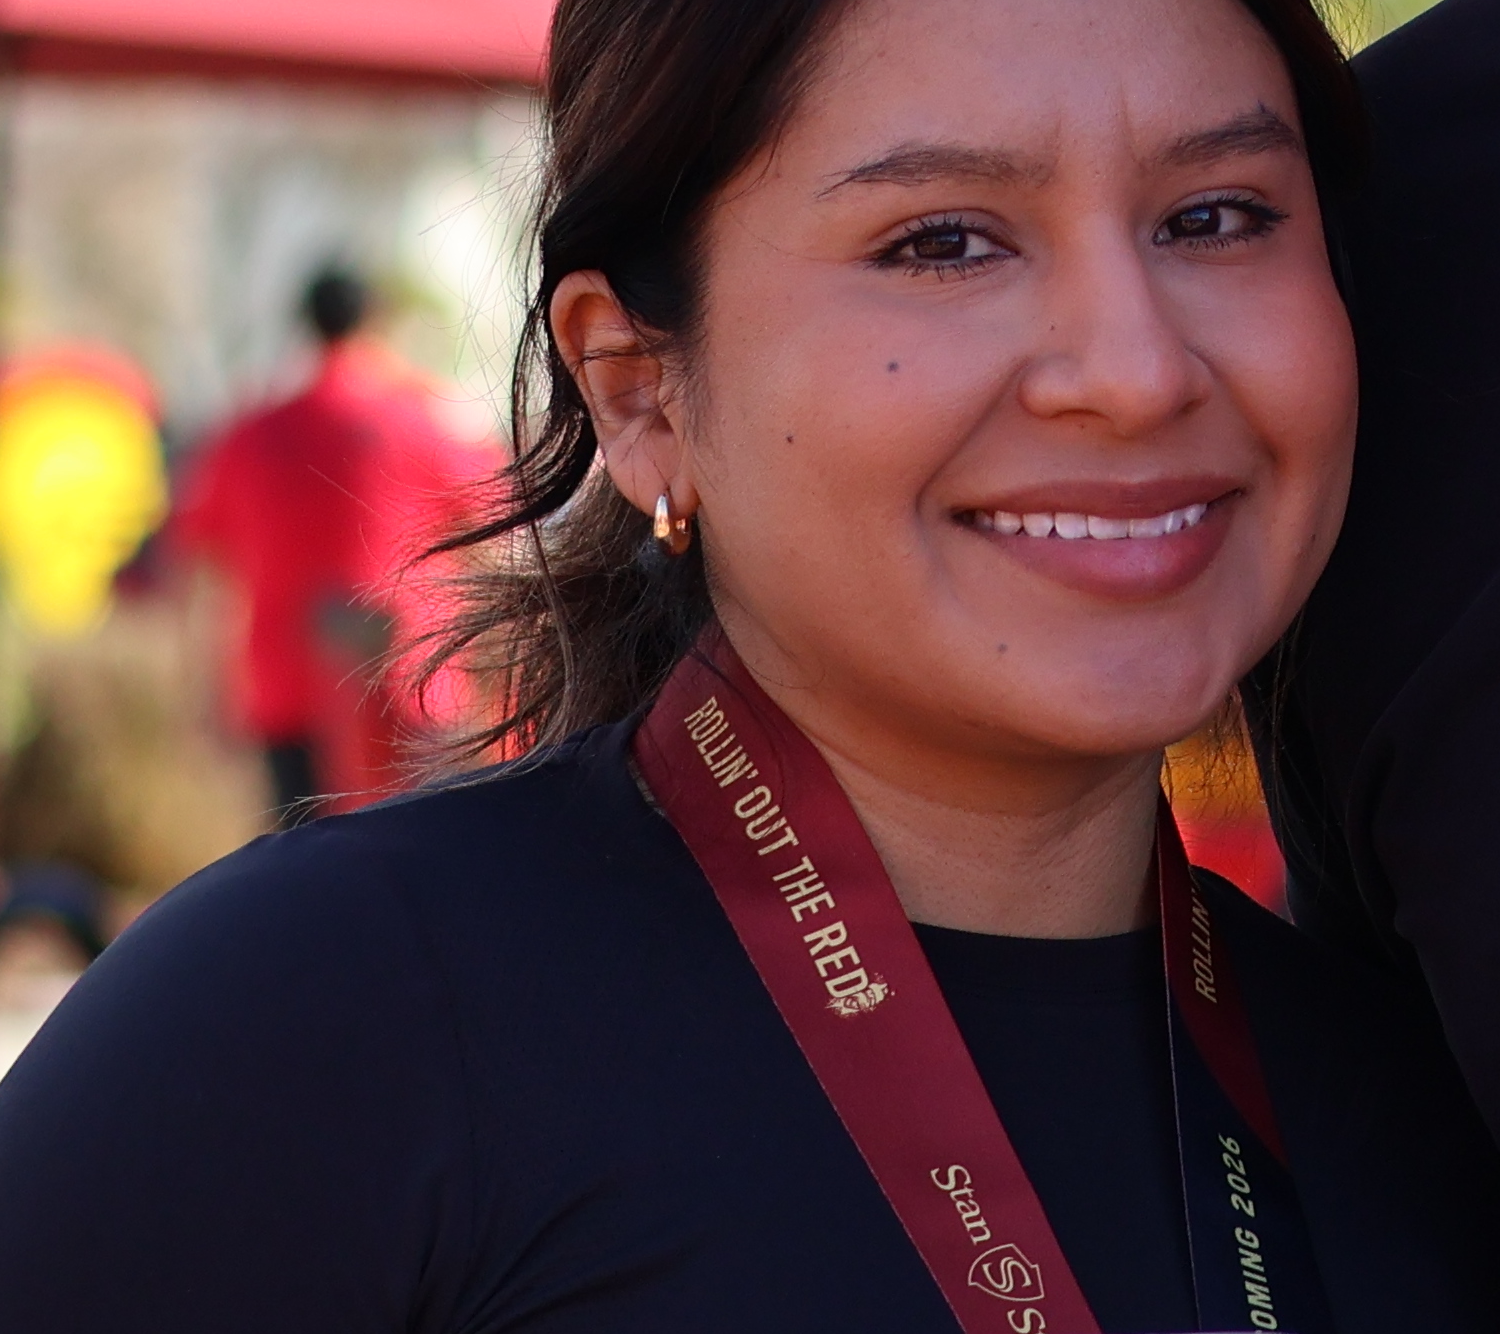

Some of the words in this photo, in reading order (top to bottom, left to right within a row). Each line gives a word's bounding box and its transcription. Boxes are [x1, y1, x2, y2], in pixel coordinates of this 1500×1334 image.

[684, 695, 759, 788] ROLLIN'
[734, 785, 800, 856] OUT
[772, 855, 836, 923] THE
[803, 920, 870, 999] RED
[930, 1164, 992, 1246] Stan
[1218, 1132, 1256, 1218] 2026
